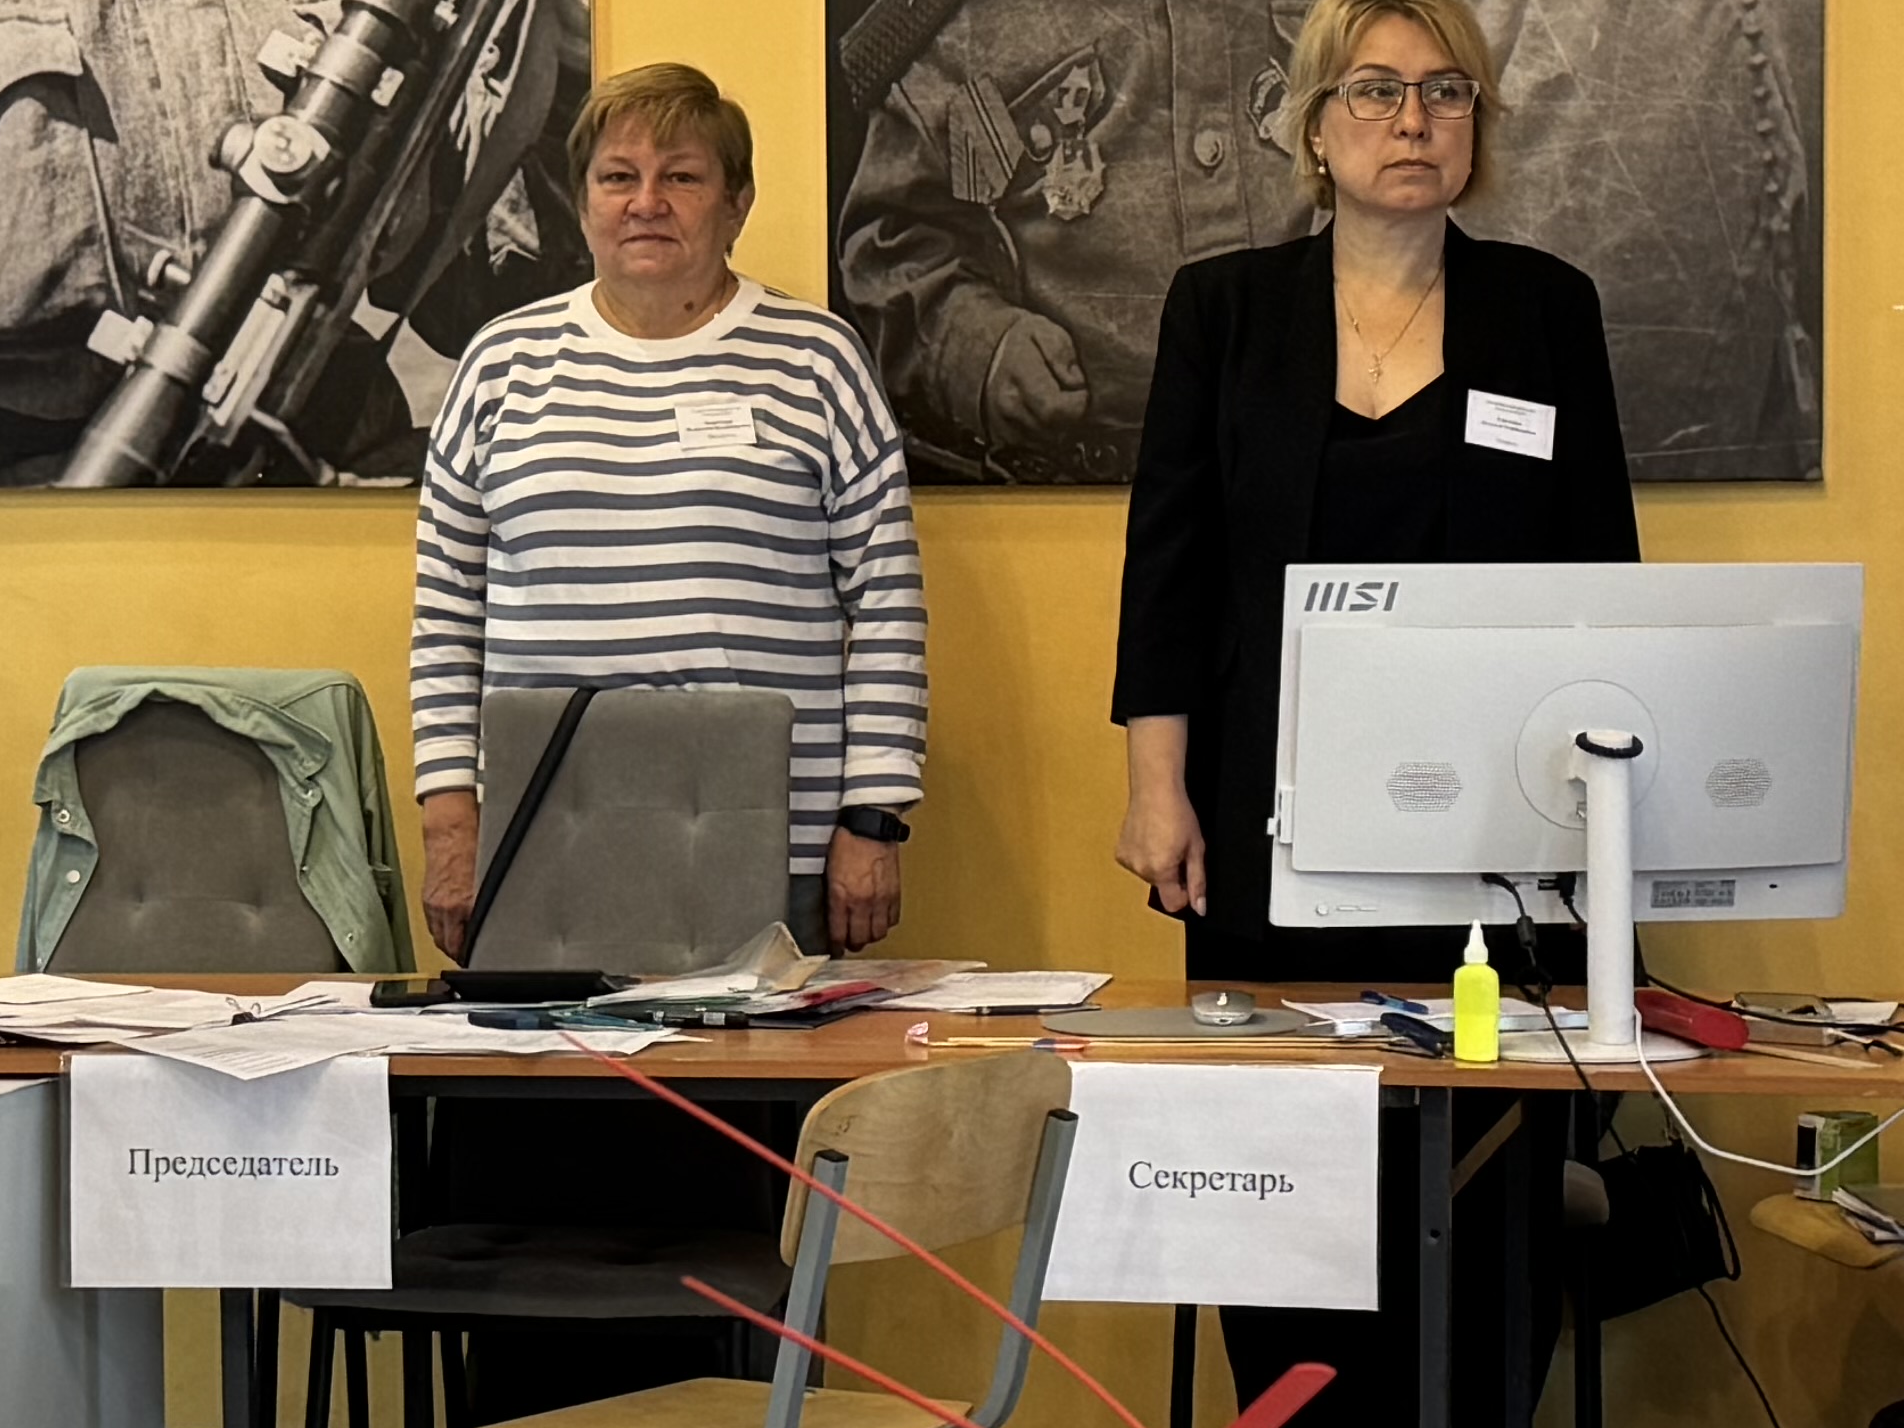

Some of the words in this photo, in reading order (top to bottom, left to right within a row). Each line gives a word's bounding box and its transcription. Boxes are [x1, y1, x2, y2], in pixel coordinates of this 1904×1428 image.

[1304, 582, 1400, 612] MSI
[128, 1148, 340, 1183] Председатель
[1128, 1161, 1295, 1200] Секретарь
